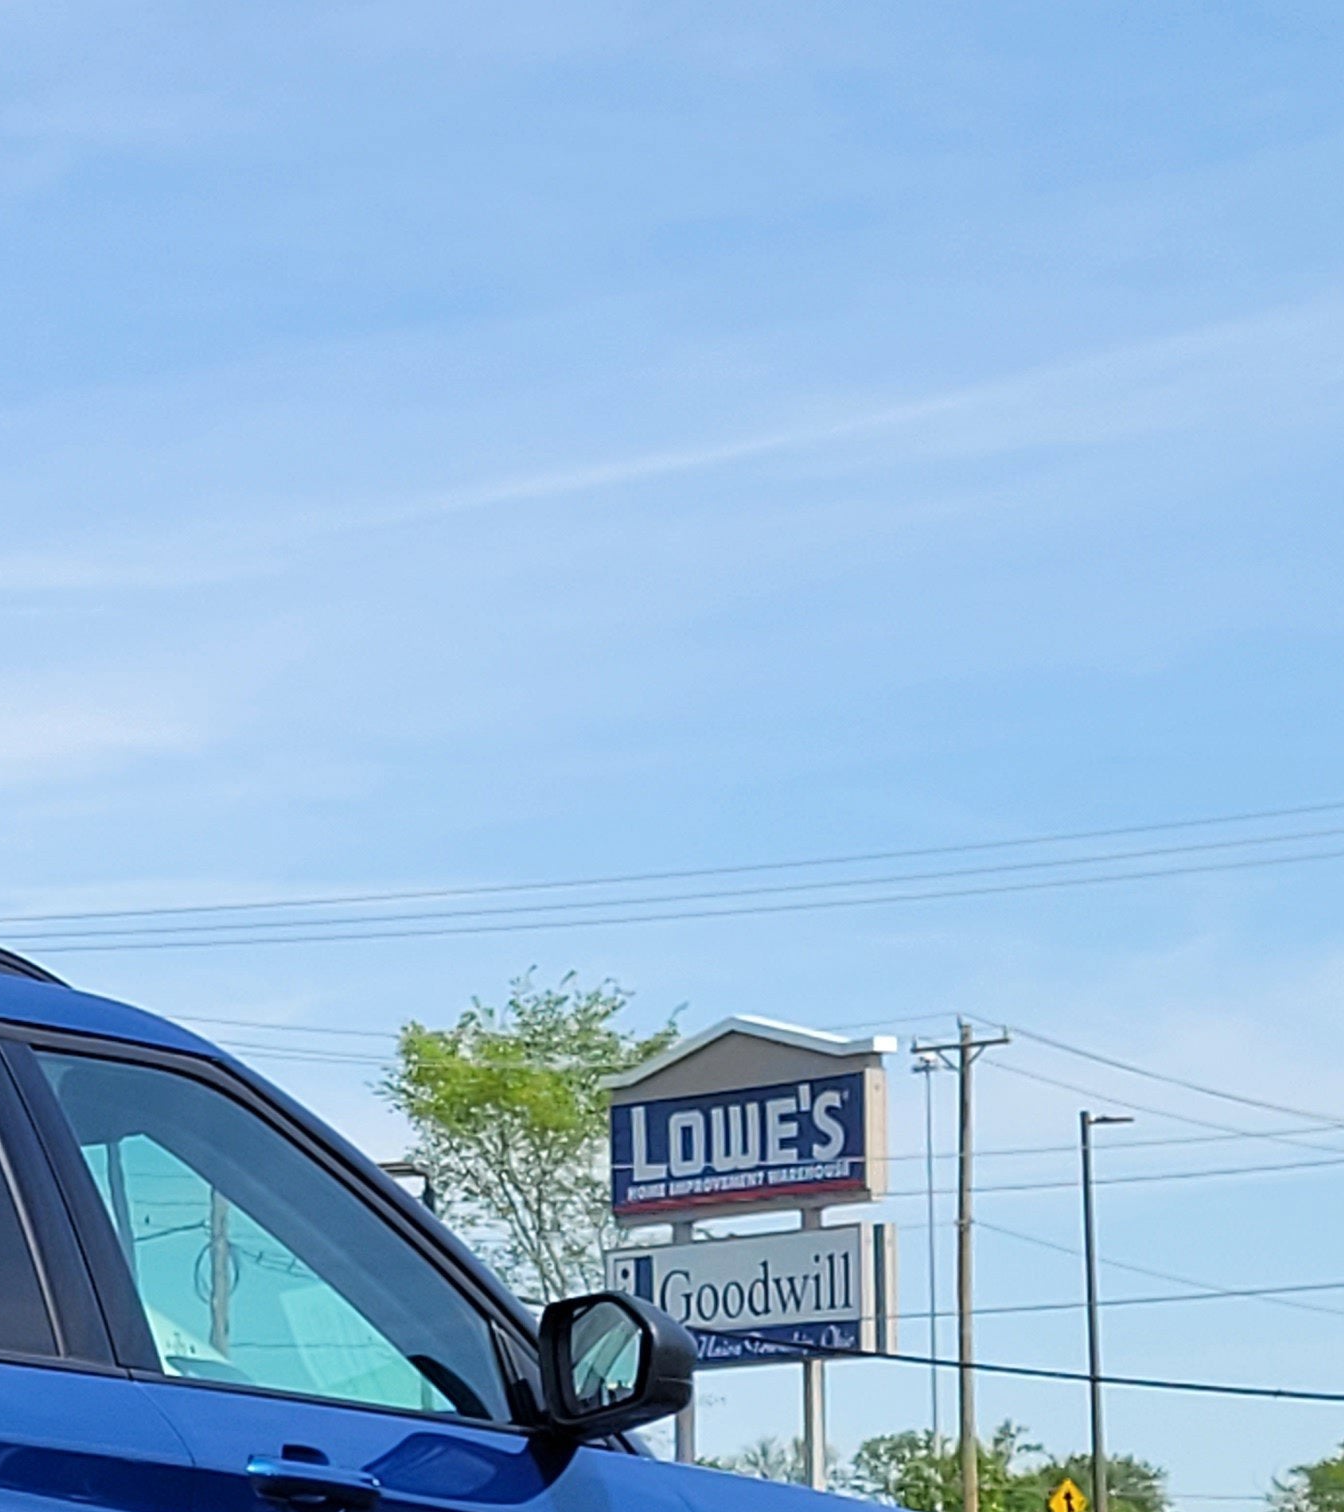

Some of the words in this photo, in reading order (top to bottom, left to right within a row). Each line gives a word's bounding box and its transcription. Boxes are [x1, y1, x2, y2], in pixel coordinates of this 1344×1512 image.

[630, 1083, 846, 1182] LOWE'S
[627, 1182, 666, 1201] HOME
[668, 1171, 765, 1196] IMPROVEMENT
[767, 1160, 851, 1185] WAREHOUSE
[660, 1251, 854, 1325] Goodwill
